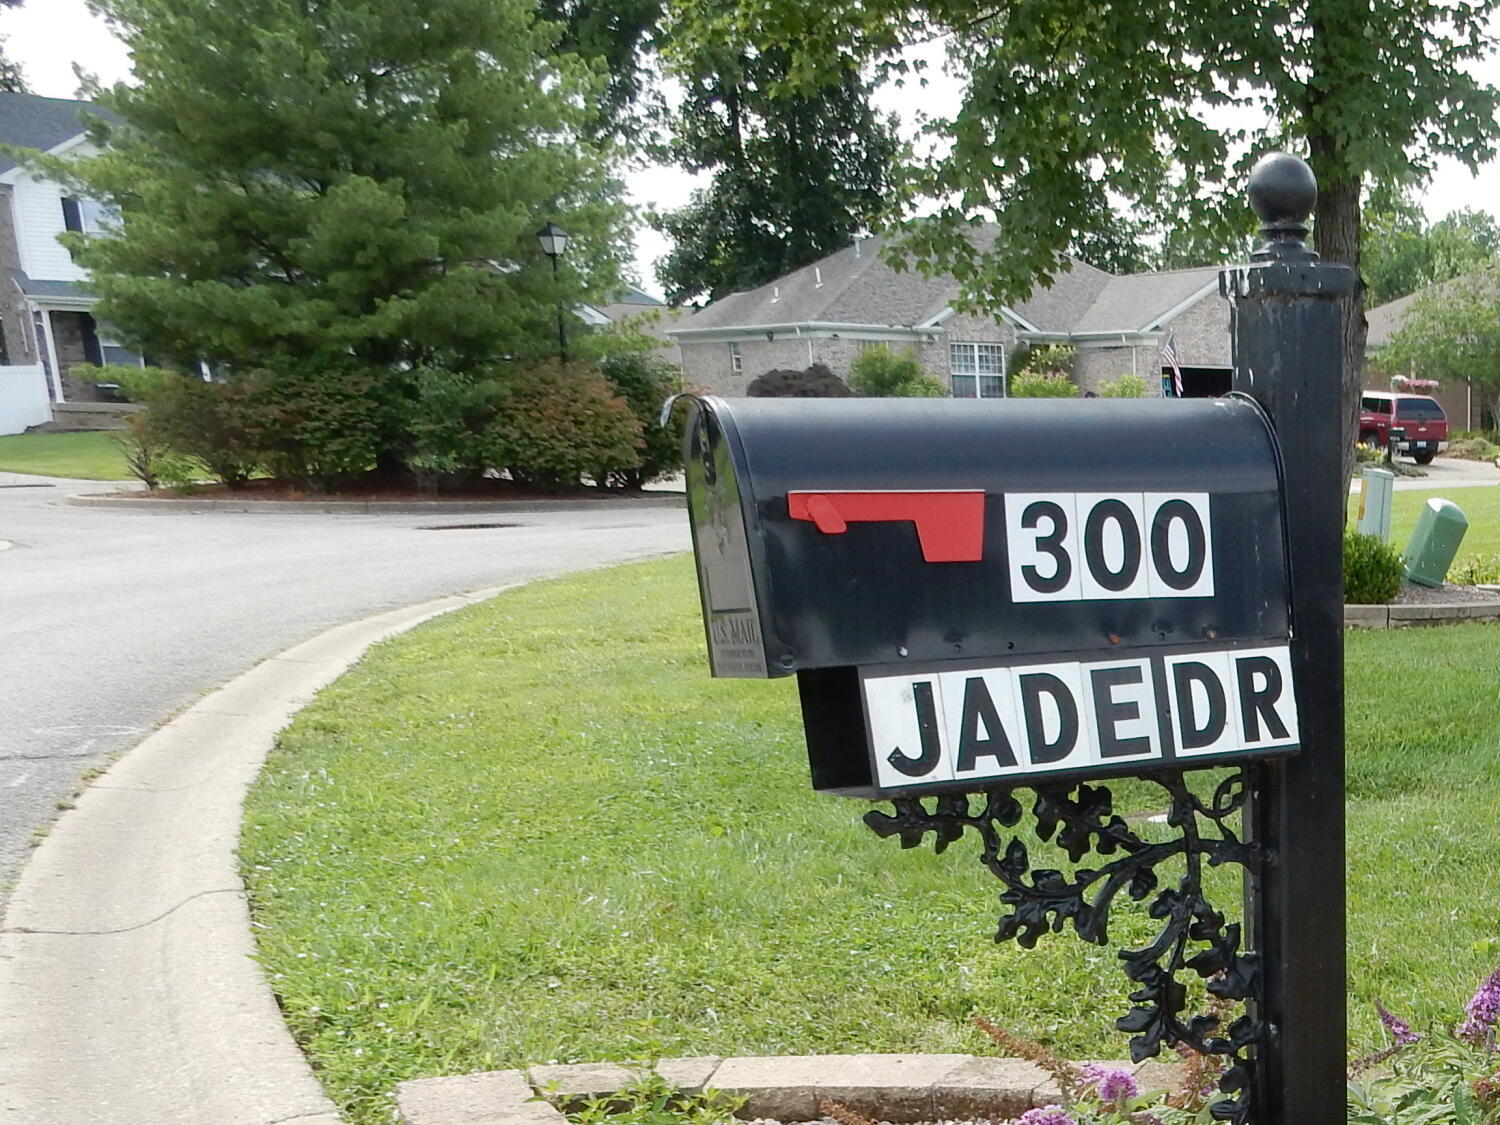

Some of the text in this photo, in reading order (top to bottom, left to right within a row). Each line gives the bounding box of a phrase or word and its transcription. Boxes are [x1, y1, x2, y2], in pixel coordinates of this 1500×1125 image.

[1021, 499, 1206, 593] 300
[888, 656, 1291, 777] JADE DR
